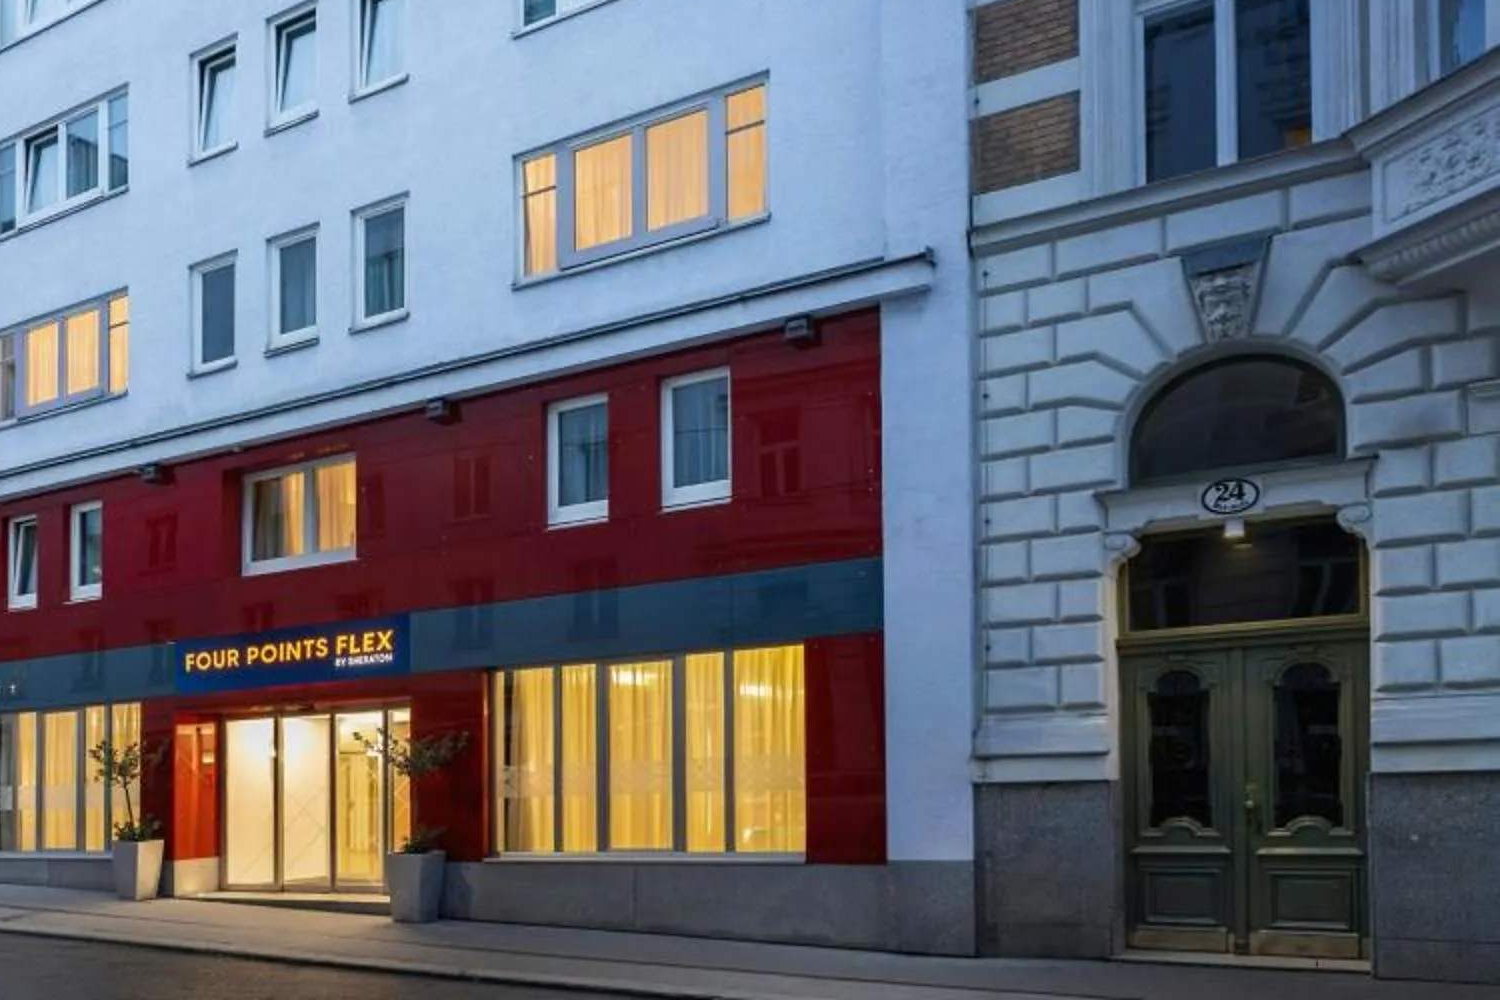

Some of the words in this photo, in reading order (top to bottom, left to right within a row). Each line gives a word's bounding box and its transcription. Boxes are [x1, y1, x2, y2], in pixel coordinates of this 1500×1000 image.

[1214, 482, 1246, 503] 24
[185, 648, 240, 673] FOUR
[246, 637, 329, 665] POINTS
[336, 629, 393, 655] FLEX
